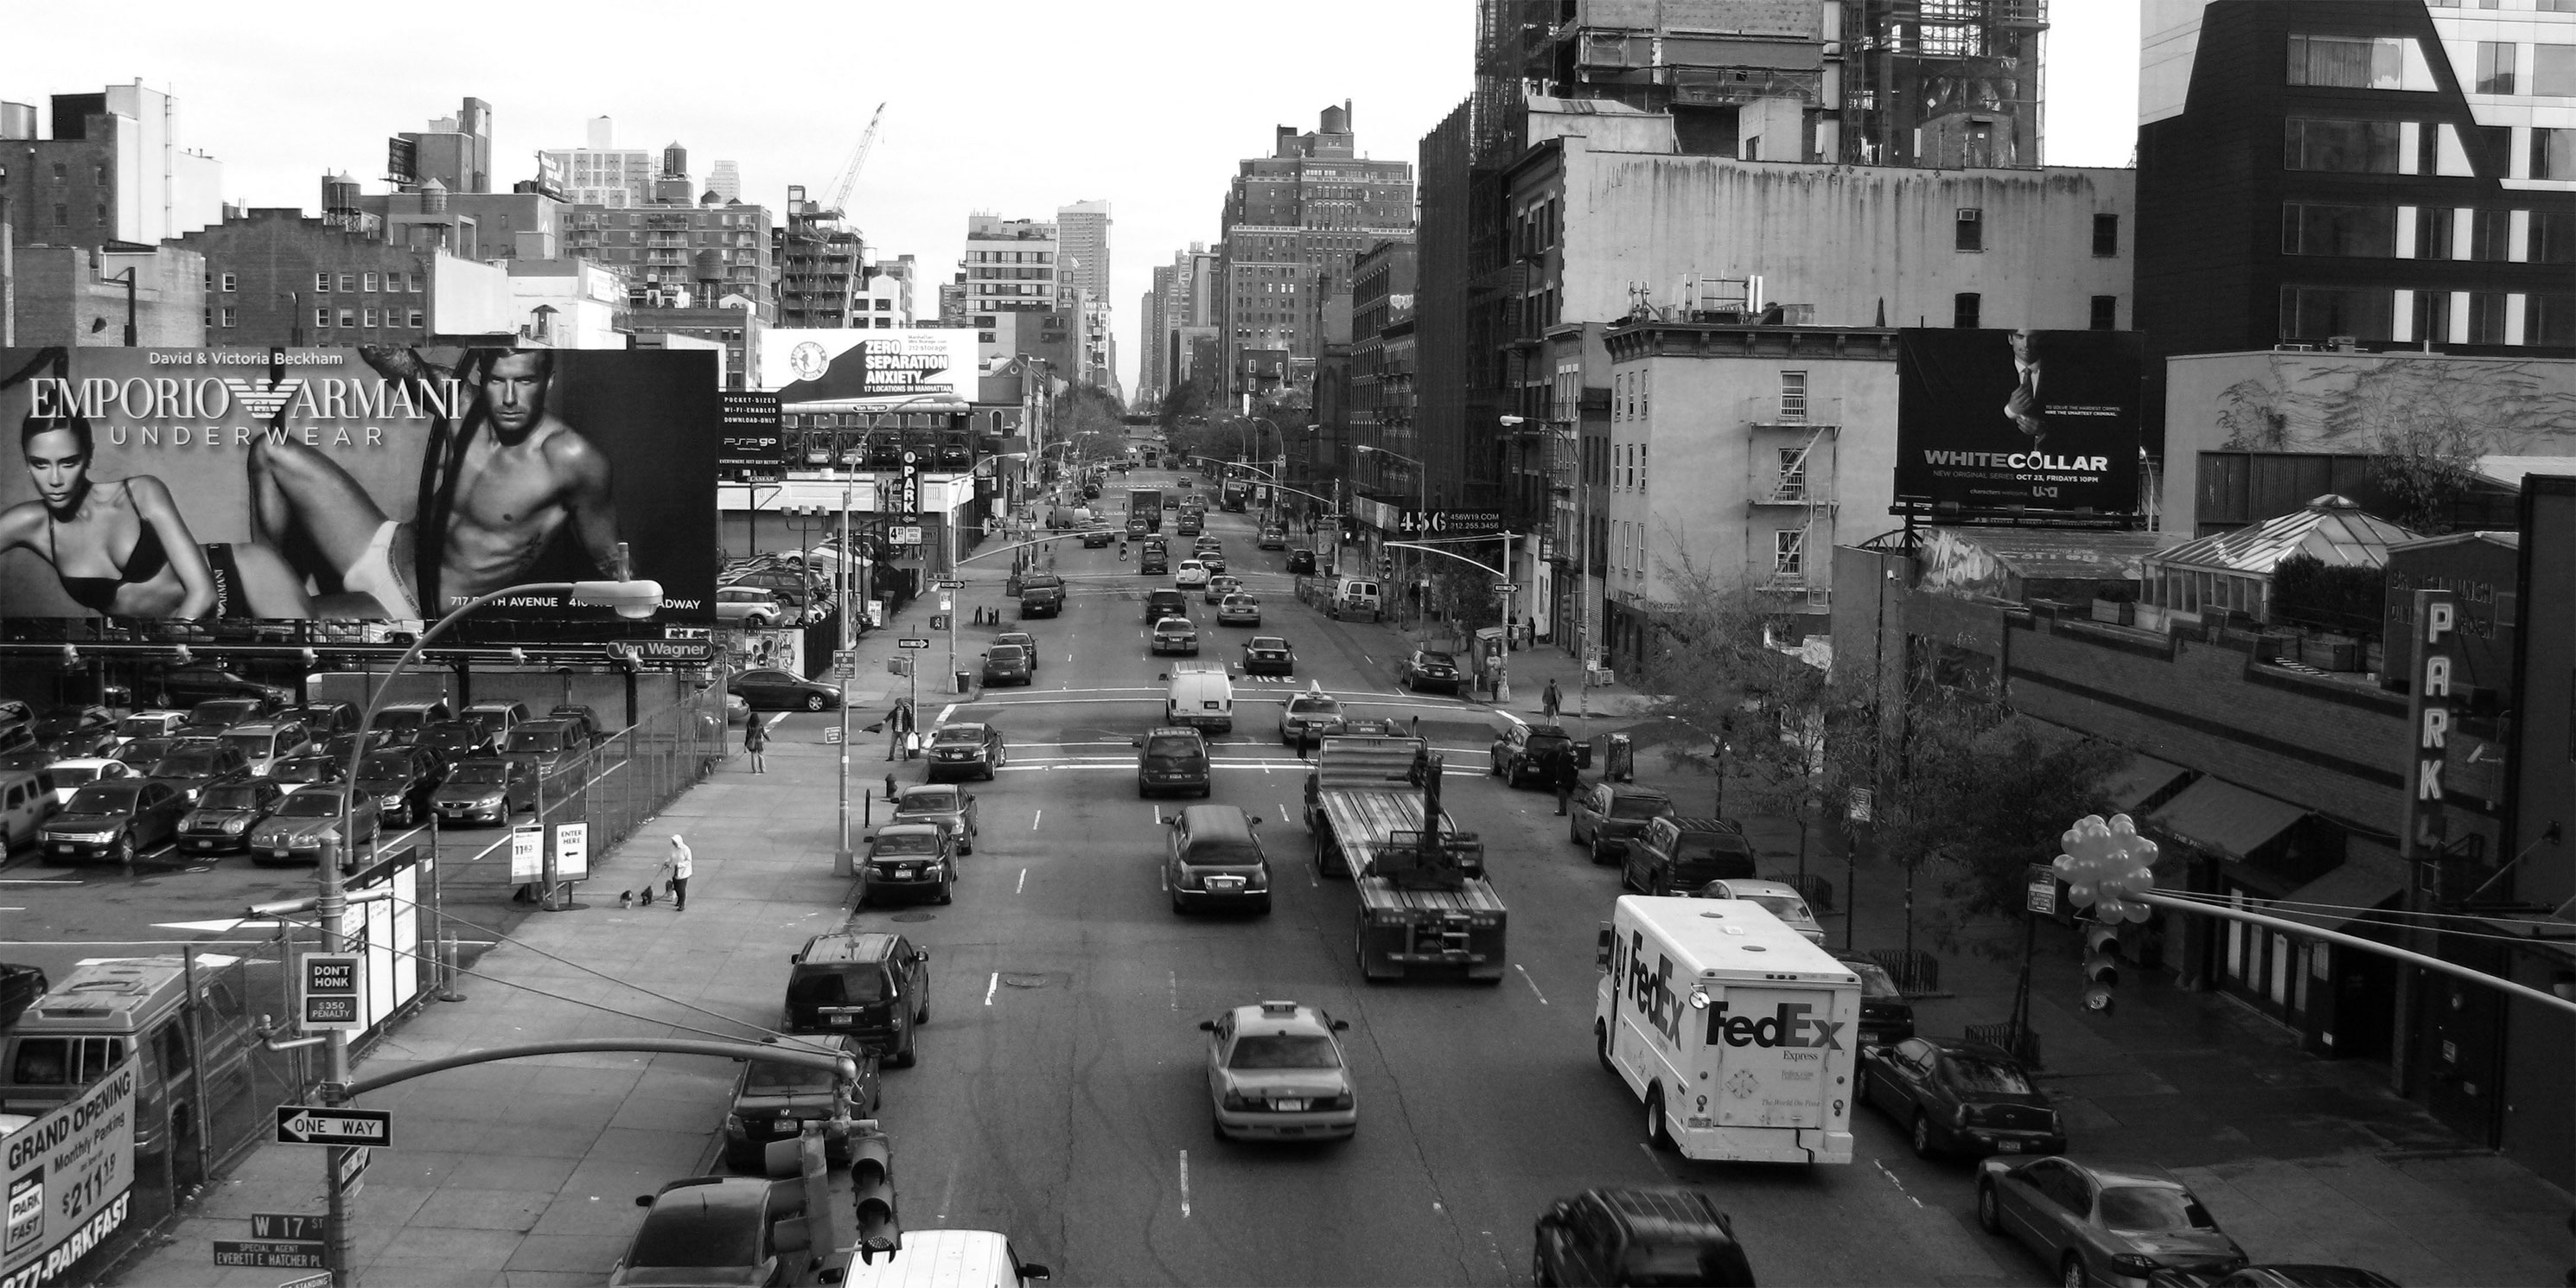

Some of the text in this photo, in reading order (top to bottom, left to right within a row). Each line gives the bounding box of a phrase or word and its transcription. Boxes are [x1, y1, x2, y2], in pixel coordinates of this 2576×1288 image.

[864, 340, 901, 354] ZERO
[150, 352, 343, 365] David & Victoria Beckham
[864, 354, 948, 370] SEPARATION
[865, 370, 924, 385] ANXIETY.
[29, 377, 462, 420] EMPORIO ARMANI
[111, 426, 382, 445] UNDERWEAR
[1400, 512, 1447, 532] 456
[450, 596, 469, 606] 717
[510, 596, 558, 607] AVENUE
[616, 642, 706, 657] Van Wagner
[2420, 603, 2454, 800] PARK
[315, 966, 351, 975] DON'T
[315, 978, 349, 987] HONK
[1628, 928, 1686, 1053] FedEx
[1706, 1001, 1846, 1050] FedEx
[1782, 1050, 1819, 1062] Express
[1762, 1099, 1774, 1107] The
[8, 1070, 131, 1172] GRAND OPENING
[295, 1119, 376, 1135] ONE WAY
[54, 1111, 125, 1175] Monthly Parking
[12, 1190, 41, 1219] PARK
[11, 1215, 41, 1244] FAST
[255, 1216, 324, 1237] W 17 ST
[239, 1243, 299, 1253] SPECIAL AGENT
[217, 1253, 322, 1267] EVERETT E HATCHER PL
